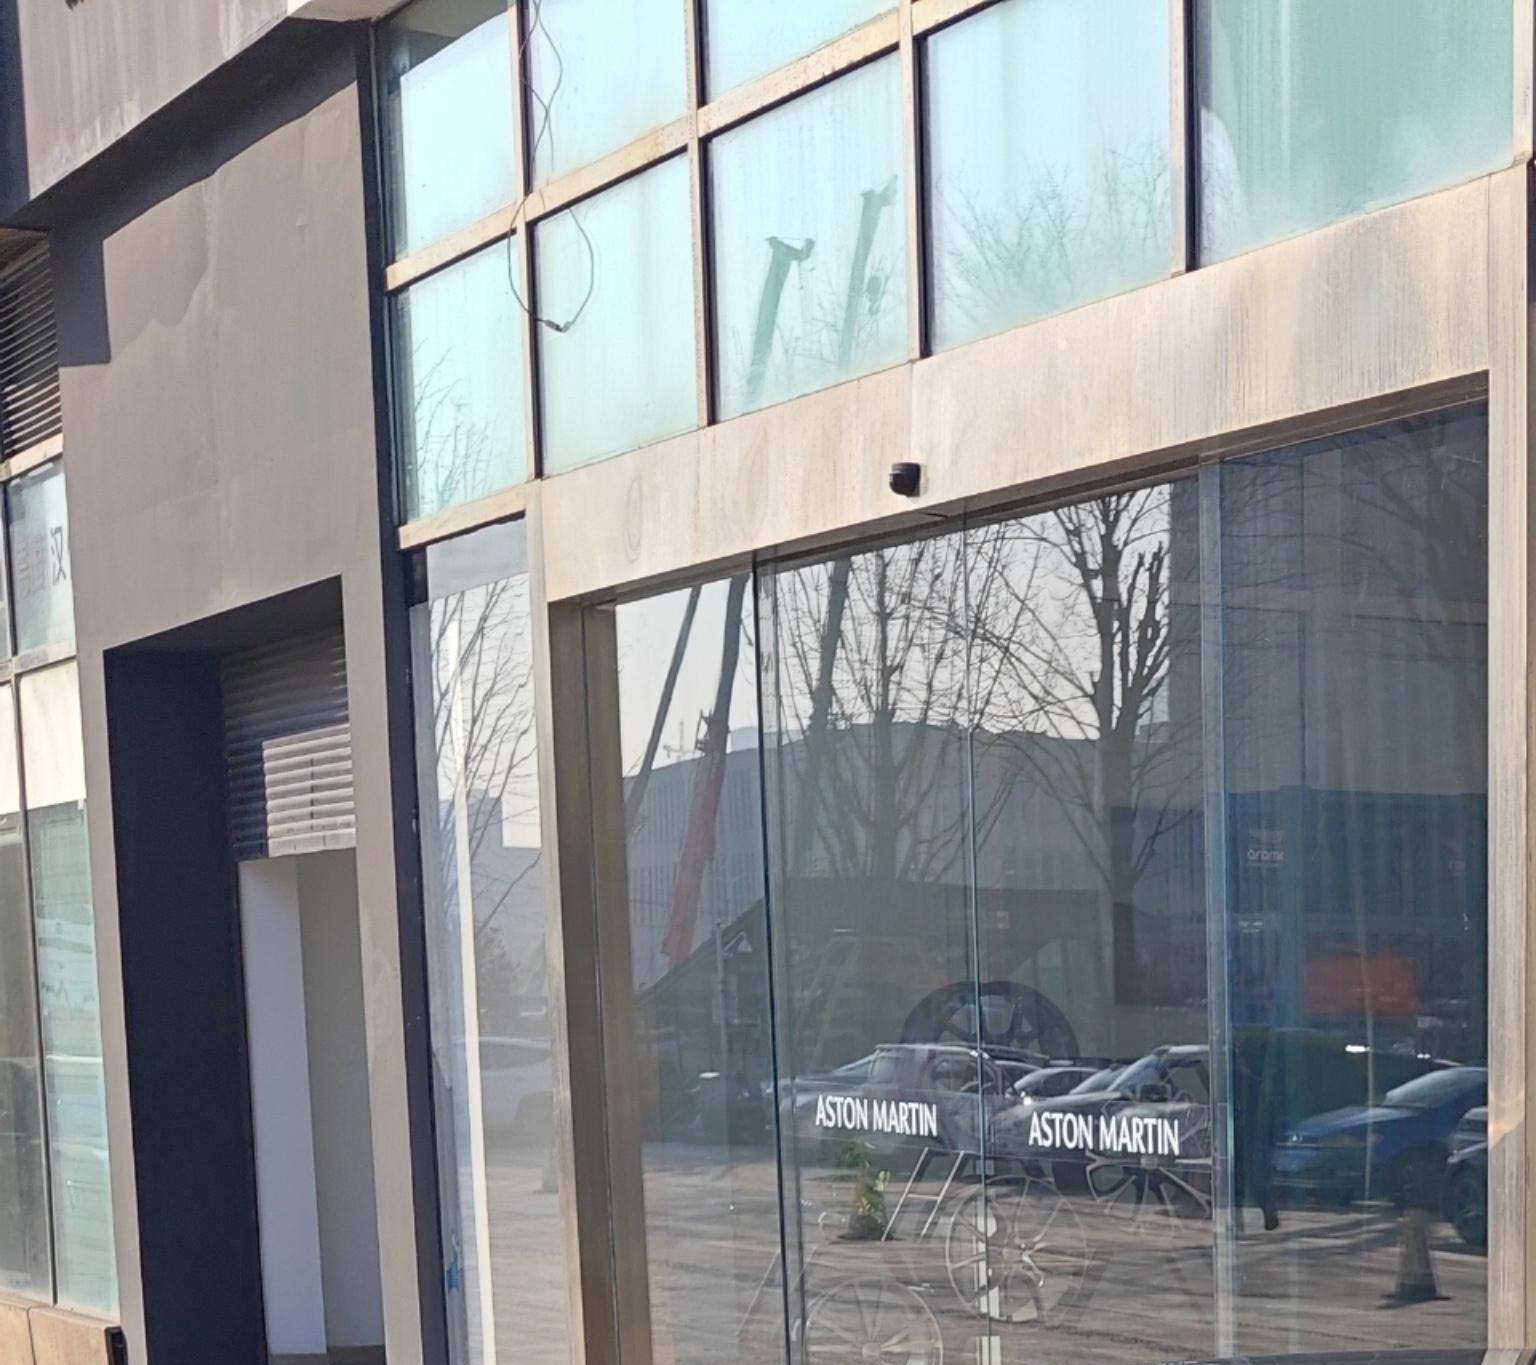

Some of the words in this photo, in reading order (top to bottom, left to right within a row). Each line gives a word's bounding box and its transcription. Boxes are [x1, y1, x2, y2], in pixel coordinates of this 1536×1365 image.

[815, 1095, 868, 1130] ASTON
[872, 1099, 938, 1137] MARTIN
[1028, 1112, 1094, 1150] ASTON
[1099, 1116, 1180, 1156] MARTIN
